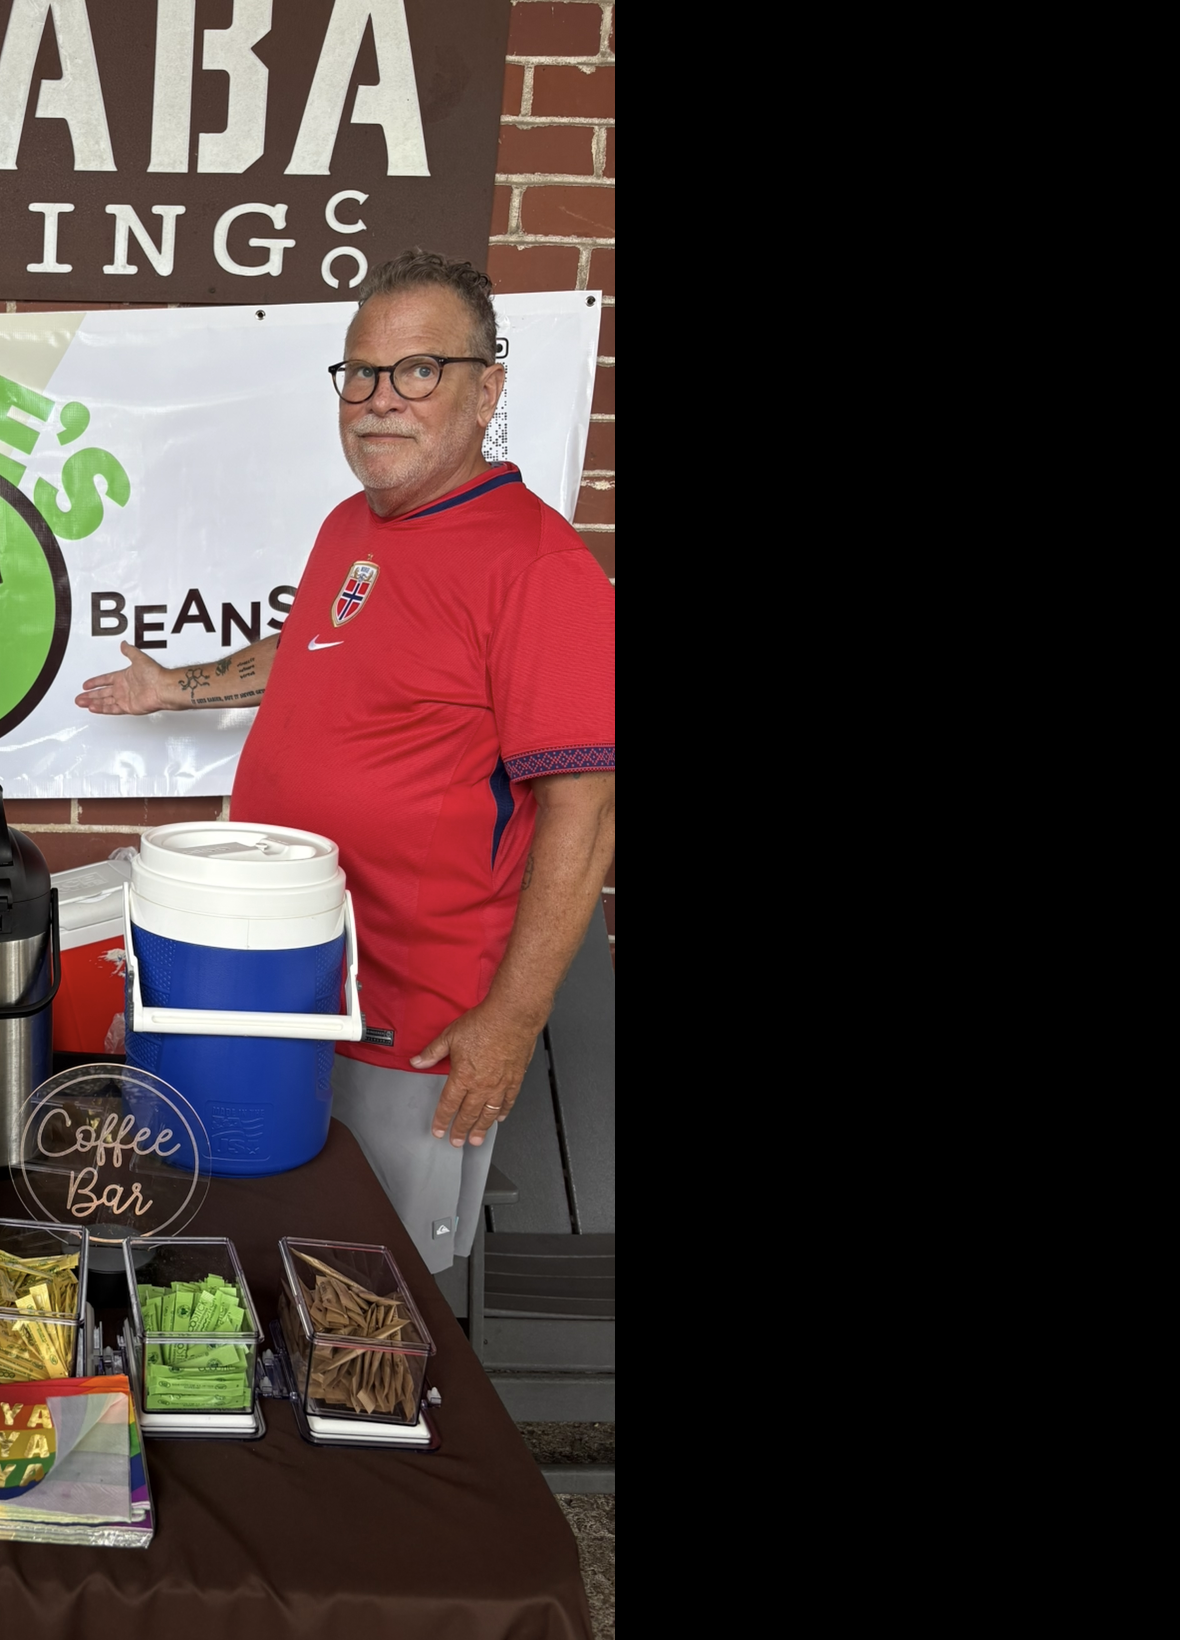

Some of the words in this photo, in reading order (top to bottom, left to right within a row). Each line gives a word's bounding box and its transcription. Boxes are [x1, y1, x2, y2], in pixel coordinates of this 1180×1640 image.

[37, 1108, 181, 1168] Coffee
[66, 1167, 153, 1218] Bar
[0, 1402, 52, 1429] YA
